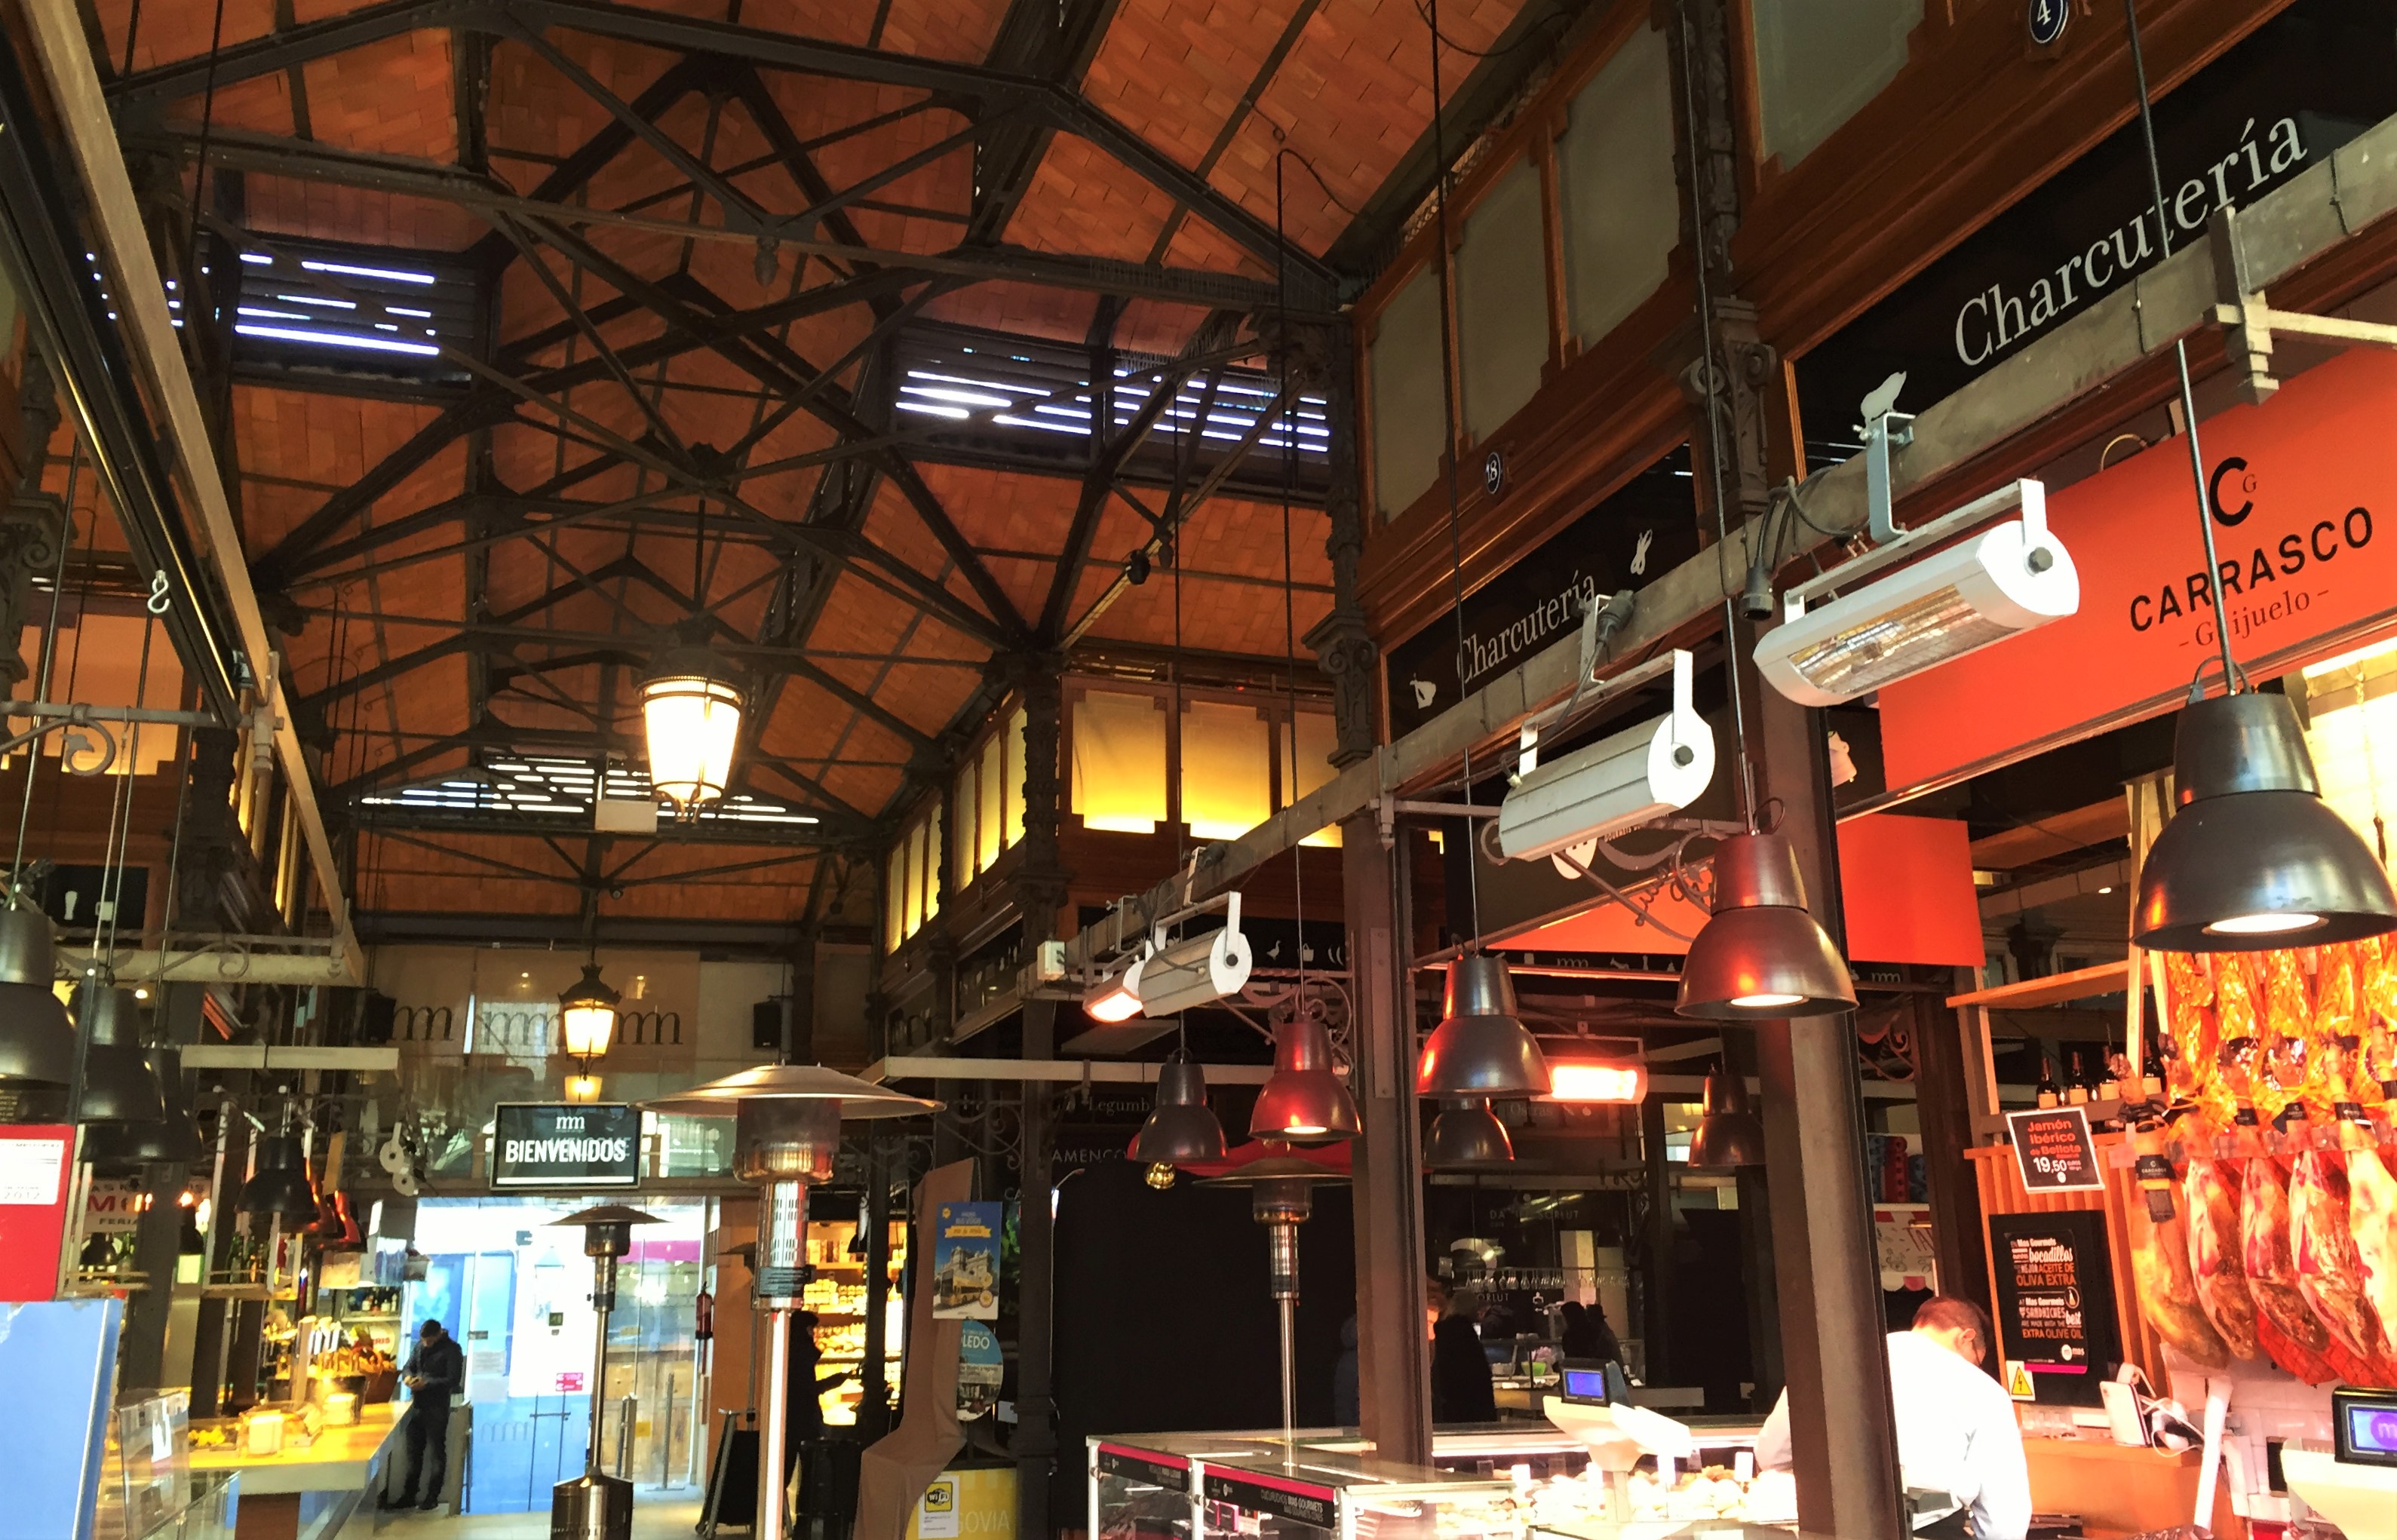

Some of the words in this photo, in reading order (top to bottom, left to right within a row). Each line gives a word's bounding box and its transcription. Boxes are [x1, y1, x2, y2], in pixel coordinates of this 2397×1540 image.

[2037, 0, 2052, 26] 4
[2130, 507, 2373, 632] CARRASCO
[1456, 569, 1595, 684] Charcutería
[2196, 591, 2310, 647] Gijuelo
[1088, 1097, 1150, 1115] Legumb
[2027, 1119, 2073, 1132] Jamón
[505, 1140, 626, 1163] BIENVENIDOS
[2040, 1144, 2082, 1155] Bellota
[2033, 1156, 2067, 1173] 19,50
[2029, 1244, 2073, 1263] bocadillos
[2038, 1263, 2064, 1273] ACEITE
[2064, 1262, 2074, 1273] DE
[2016, 1274, 2044, 1287] OLIVA
[2046, 1273, 2076, 1286] EXTRA
[2022, 1329, 2045, 1338] EXTRA
[2046, 1329, 2070, 1339] OLIVE
[960, 1336, 990, 1350] LEDO
